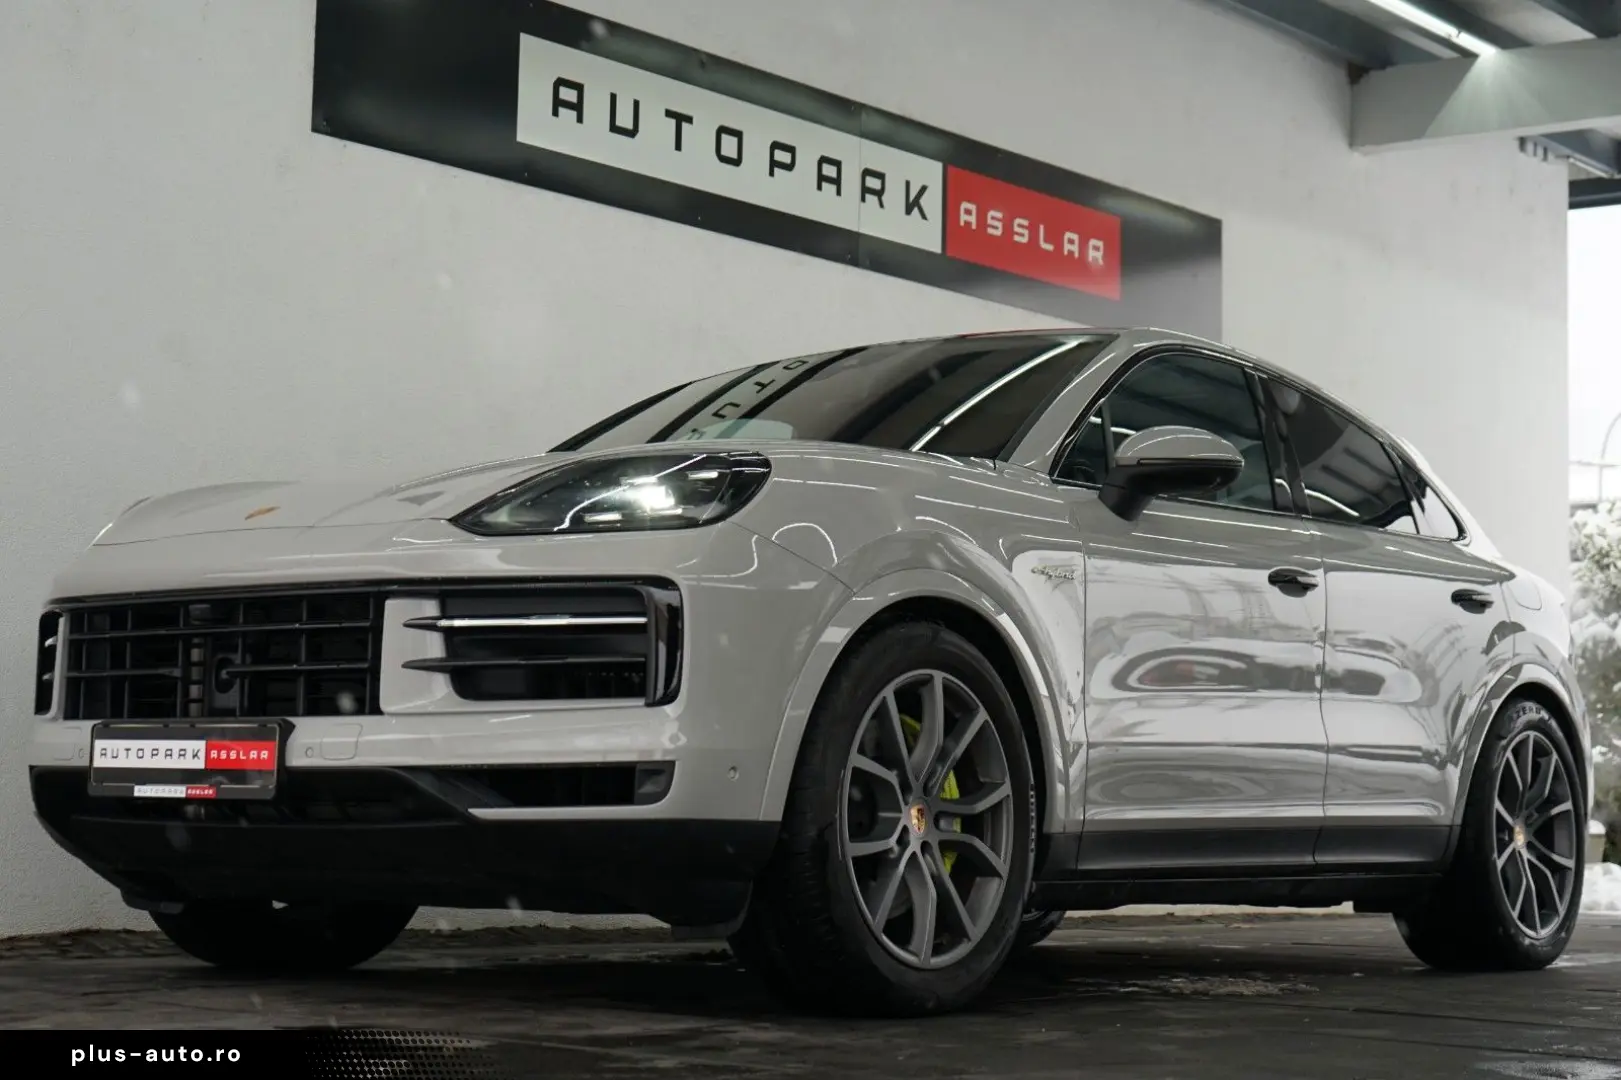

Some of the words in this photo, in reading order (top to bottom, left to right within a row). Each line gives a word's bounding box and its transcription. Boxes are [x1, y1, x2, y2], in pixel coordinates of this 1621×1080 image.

[551, 76, 929, 221] AUTOPARK
[959, 201, 1105, 265] ASSLAR
[100, 747, 200, 760] AUTOPARK
[210, 749, 268, 760] ASSLAR
